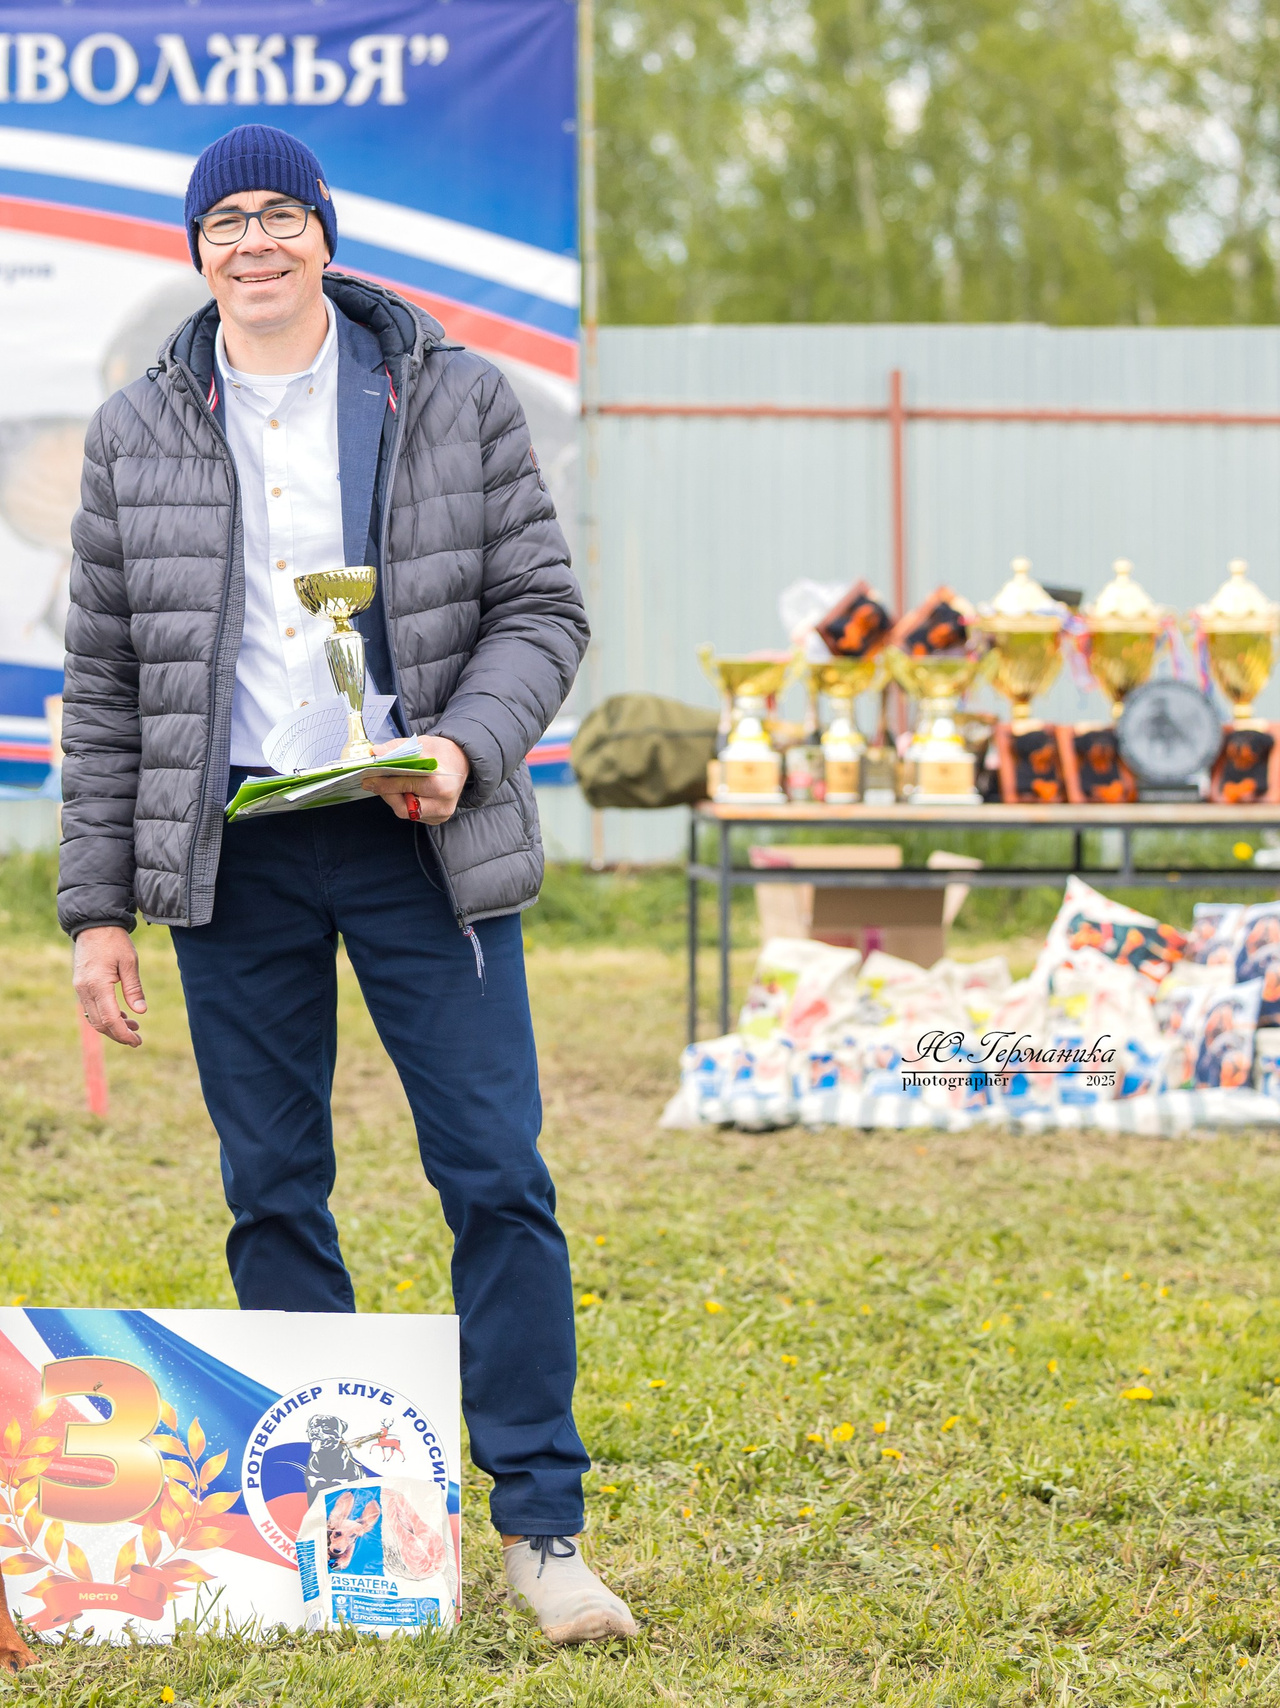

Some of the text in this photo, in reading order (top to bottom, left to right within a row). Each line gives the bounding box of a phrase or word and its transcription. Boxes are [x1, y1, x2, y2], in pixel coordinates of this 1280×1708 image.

[38, 1355, 166, 1526] 3
[247, 1386, 323, 1489] РОТВЕЙЛЕР
[338, 1383, 395, 1406] КЛУБ
[78, 1592, 119, 1601] место
[342, 1577, 398, 1591] STATERA
